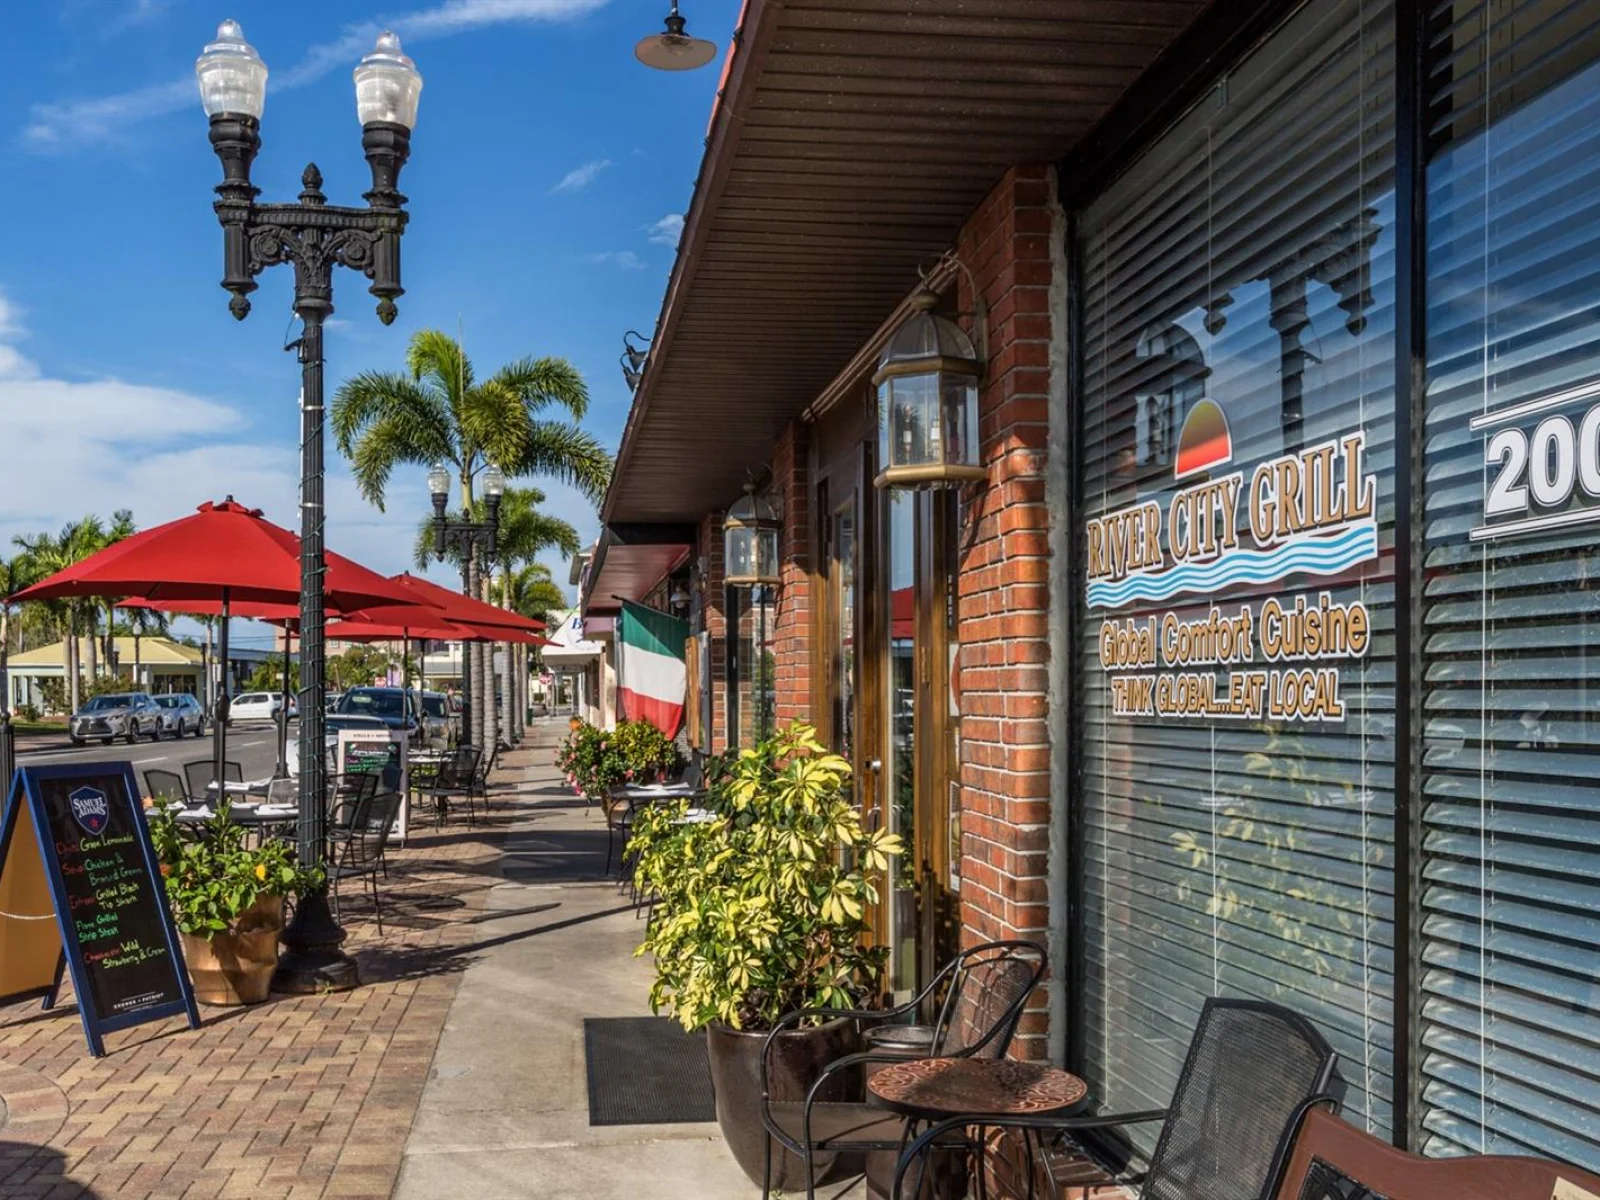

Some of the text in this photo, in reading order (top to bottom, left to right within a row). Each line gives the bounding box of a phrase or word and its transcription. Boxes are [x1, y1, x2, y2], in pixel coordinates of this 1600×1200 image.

[1087, 434, 1375, 579] RIVER CITY GRILL
[1100, 594, 1369, 667] Global Comfort Cuisine
[1113, 677, 1154, 714] THINK
[1270, 670, 1343, 718] LOCAL
[73, 797, 106, 810] SAMUEL
[79, 806, 106, 818] ADAMS
[96, 912, 118, 924] Grilled
[120, 939, 140, 952] Wild
